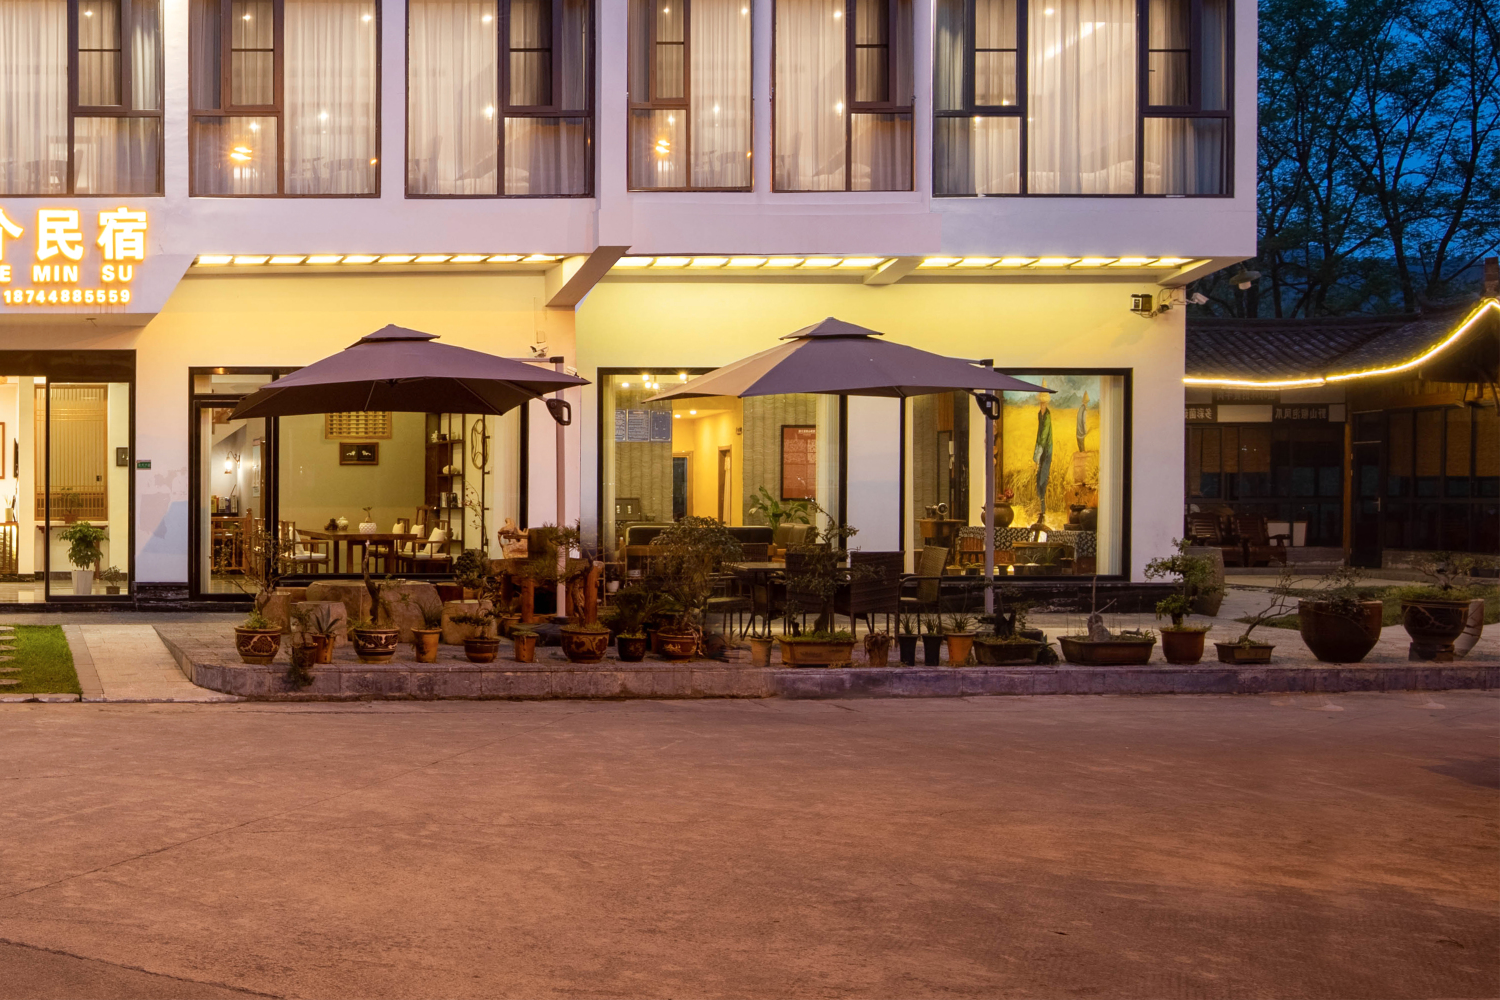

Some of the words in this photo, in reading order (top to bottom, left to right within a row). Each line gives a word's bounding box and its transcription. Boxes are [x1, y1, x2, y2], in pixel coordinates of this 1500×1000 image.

[33, 265, 78, 282] MIN
[102, 265, 132, 281] SU
[4, 289, 130, 303] 18744885559
